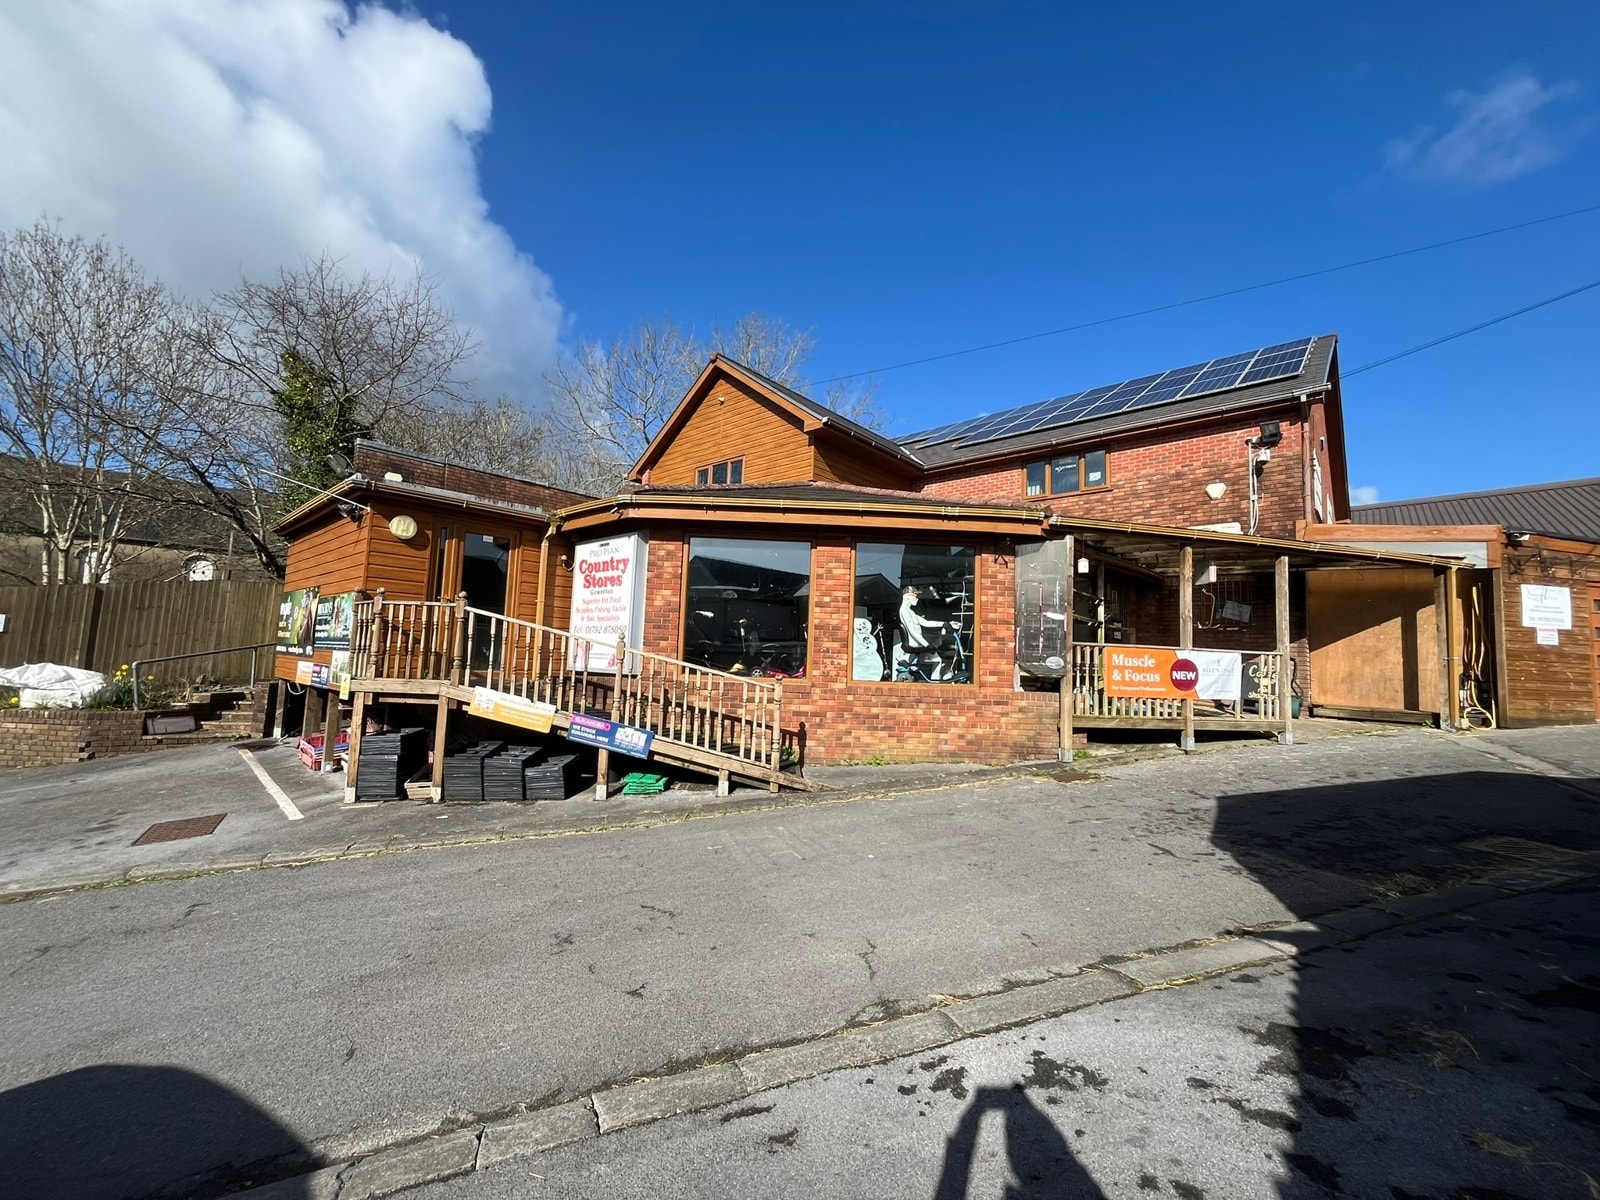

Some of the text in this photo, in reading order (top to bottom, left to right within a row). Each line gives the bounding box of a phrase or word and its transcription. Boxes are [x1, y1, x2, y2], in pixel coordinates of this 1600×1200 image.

[579, 556, 630, 575] Country
[583, 574, 623, 589] Stores
[1112, 654, 1156, 667] Muscle
[1112, 669, 1160, 682] & Focus
[1172, 671, 1196, 681] NEW
